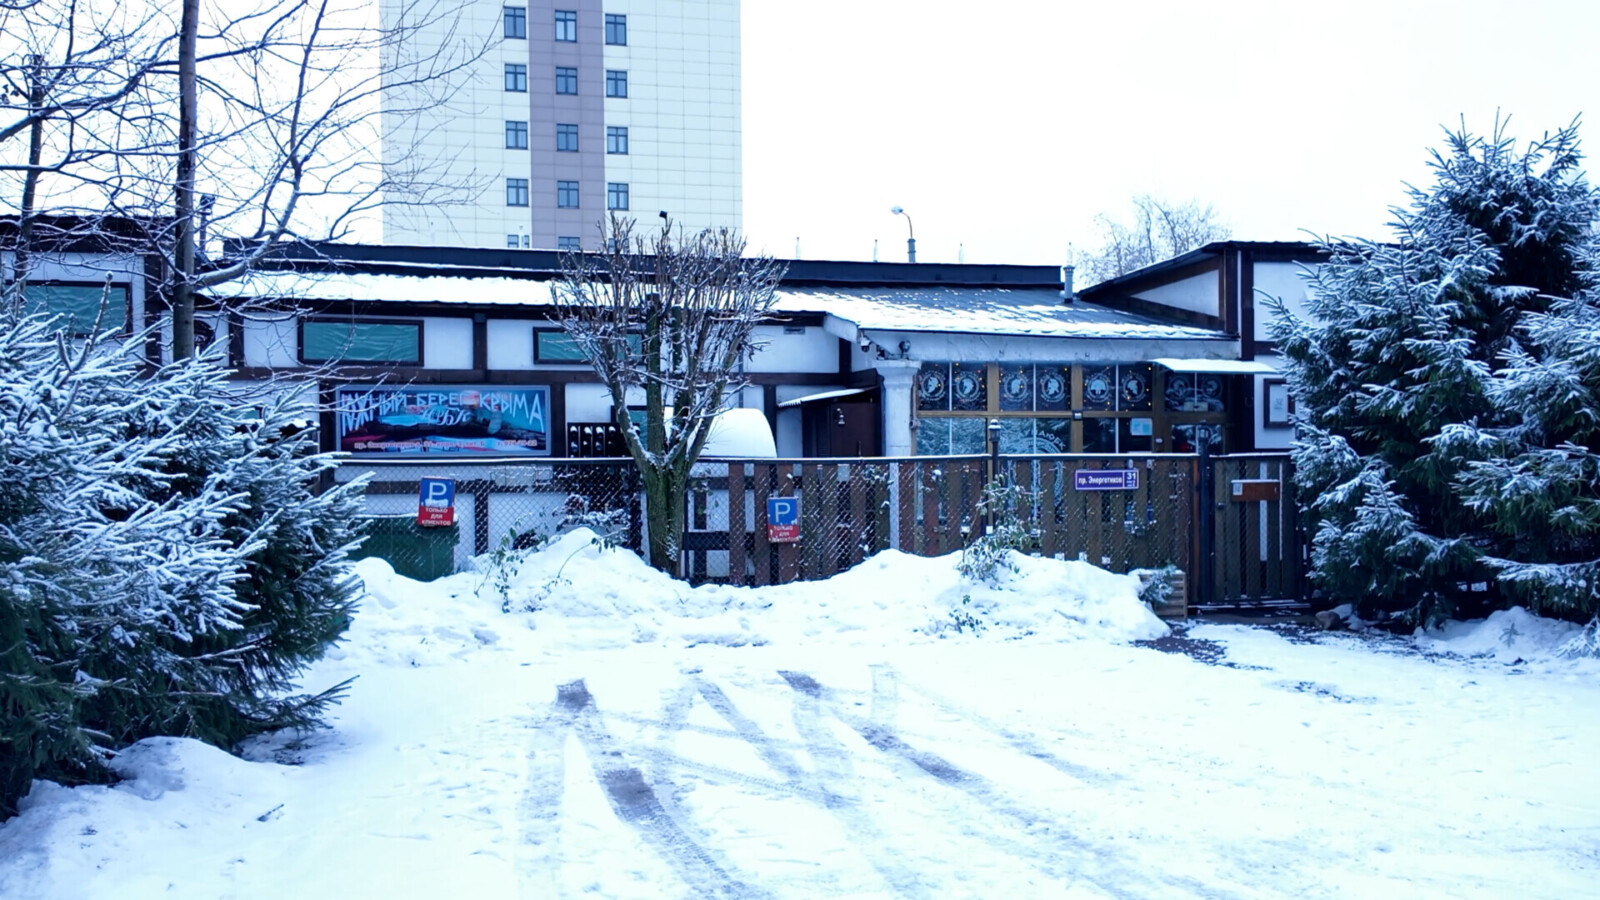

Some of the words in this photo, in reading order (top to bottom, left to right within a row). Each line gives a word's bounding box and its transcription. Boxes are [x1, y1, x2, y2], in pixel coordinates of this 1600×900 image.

[416, 392, 469, 406] БЕРЕГ
[480, 391, 545, 433] КРЫМА
[1078, 477, 1088, 485] пр.
[1088, 475, 1123, 485] Энергетиков
[1126, 472, 1137, 480] 31
